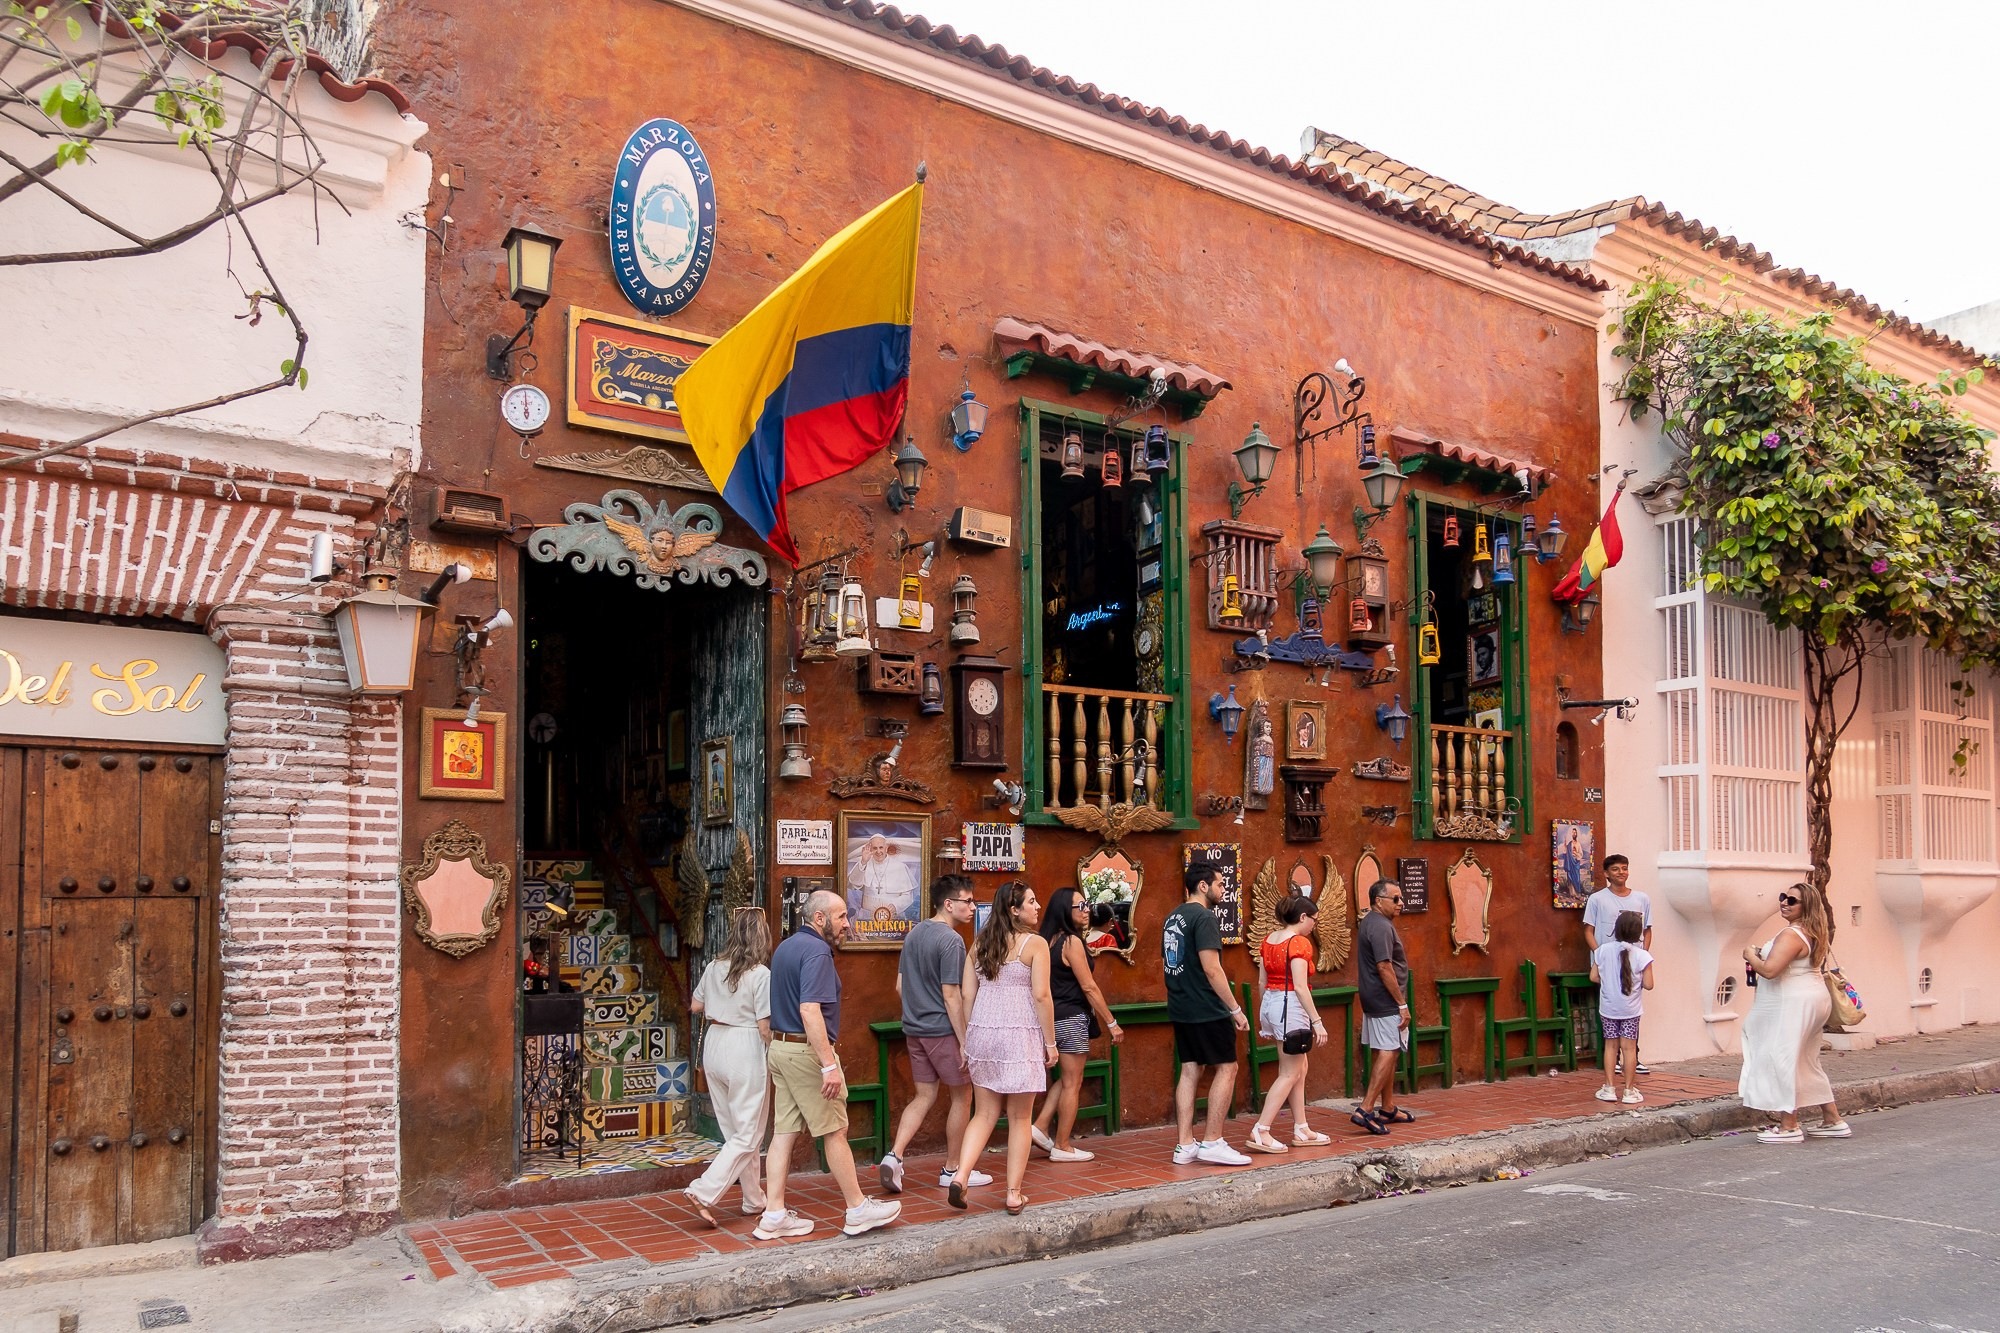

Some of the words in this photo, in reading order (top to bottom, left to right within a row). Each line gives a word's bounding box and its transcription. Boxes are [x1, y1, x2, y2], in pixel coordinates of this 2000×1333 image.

[625, 127, 709, 186] MARZOLA
[616, 201, 647, 299] PARRILLA
[652, 224, 713, 306] ARGENTINA
[616, 362, 683, 386] Marzol
[90, 658, 207, 716] Sol
[972, 836, 1013, 857] PAPA
[1206, 849, 1222, 860] NO
[966, 860, 986, 869] FRITAS
[986, 860, 990, 868] Y
[999, 861, 1018, 869] VAPOR
[855, 920, 906, 932] FRANCISCO
